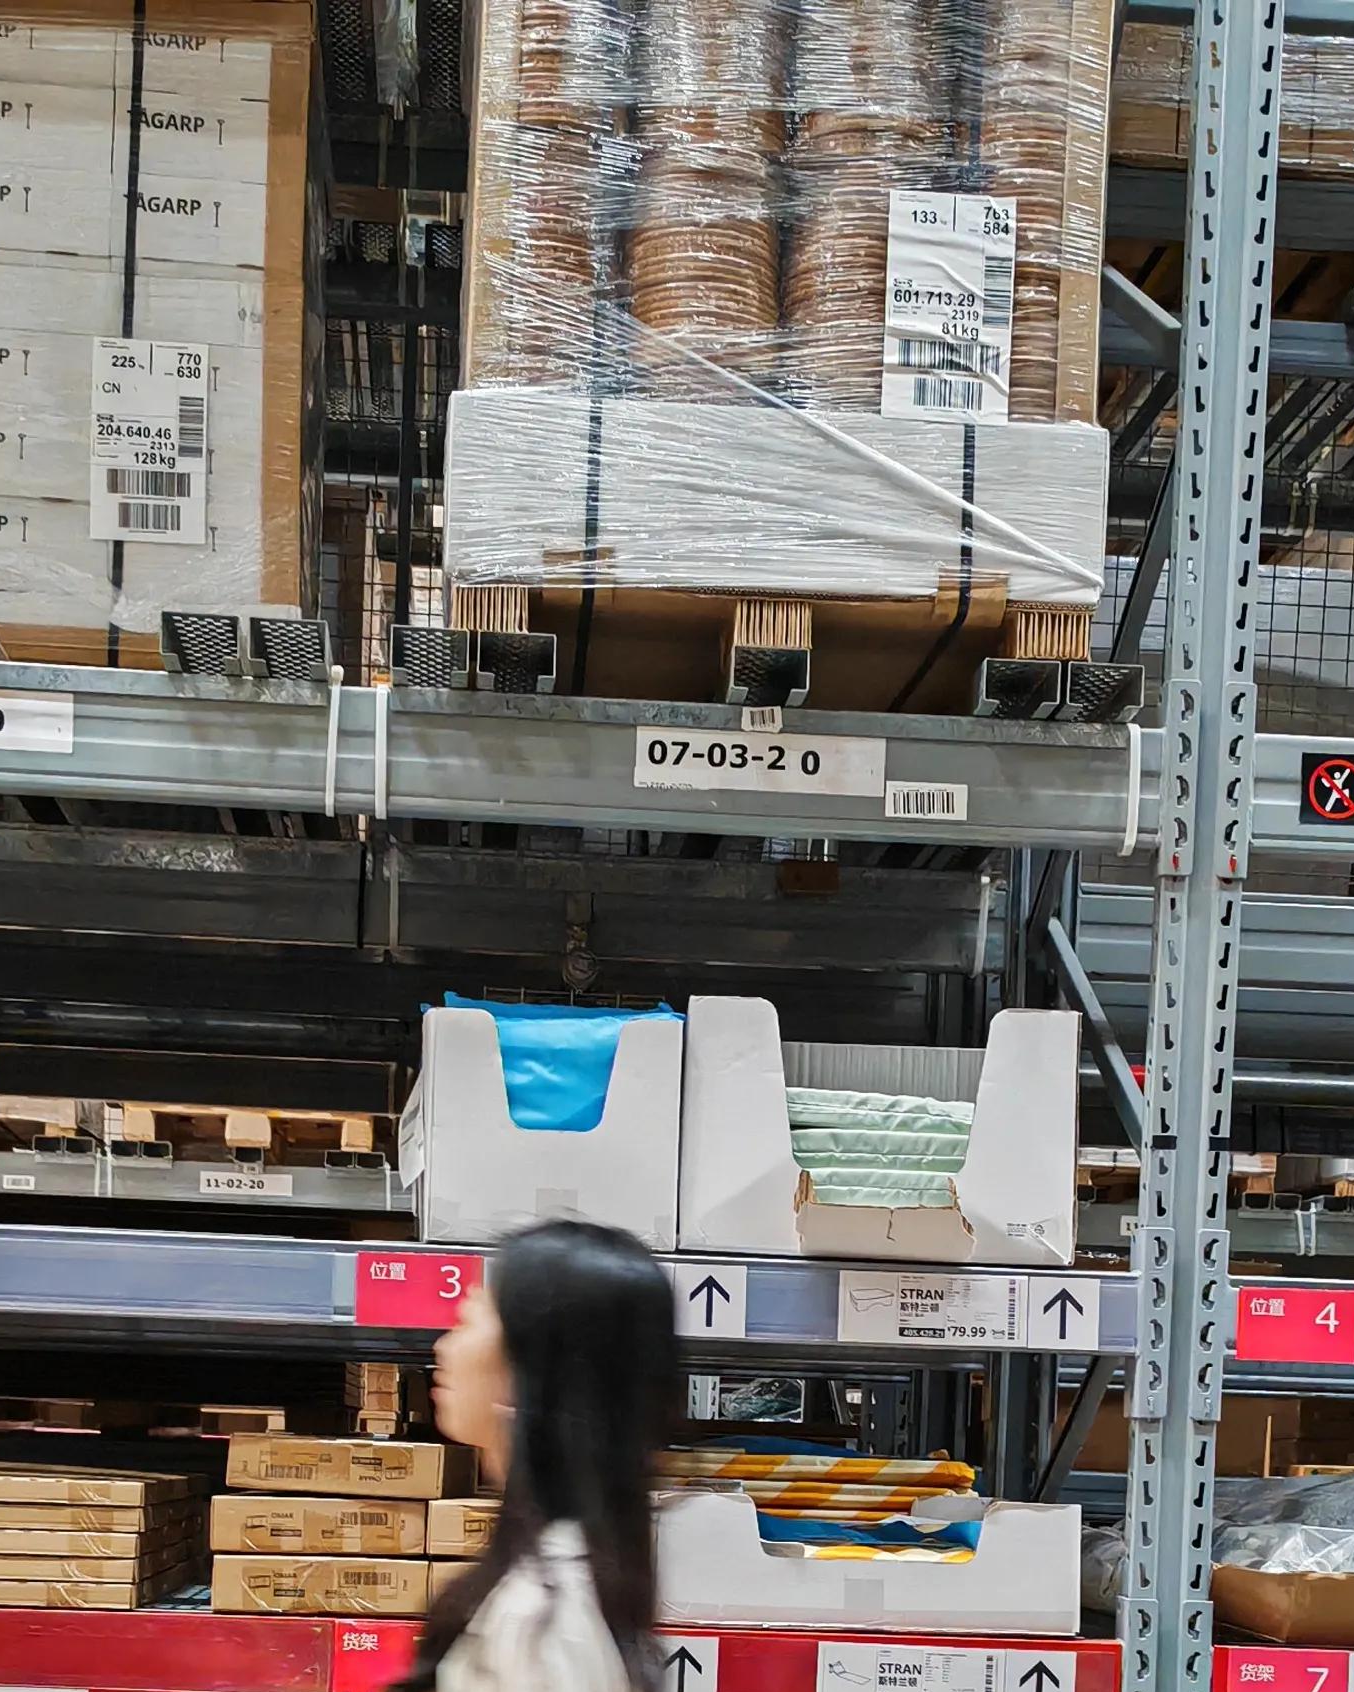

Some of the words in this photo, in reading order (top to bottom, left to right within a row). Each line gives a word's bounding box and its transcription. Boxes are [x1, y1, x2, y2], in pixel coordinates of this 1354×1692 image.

[911, 210, 937, 224] 133
[983, 221, 1010, 236] 584
[894, 289, 976, 307] 601.713.29
[951, 309, 979, 321] 2319
[111, 355, 136, 369] 225
[177, 352, 201, 366] 770
[177, 366, 201, 379] 630
[102, 382, 121, 394] CN
[97, 424, 172, 440] 204.640.46
[205, 1178, 265, 1191] 11-02-20
[369, 1260, 406, 1281] 位置
[439, 1265, 462, 1299] 3
[1249, 1297, 1286, 1317] 位置
[1315, 1301, 1340, 1334] 4
[342, 1632, 379, 1651] 货架
[1239, 1663, 1275, 1682] 货架
